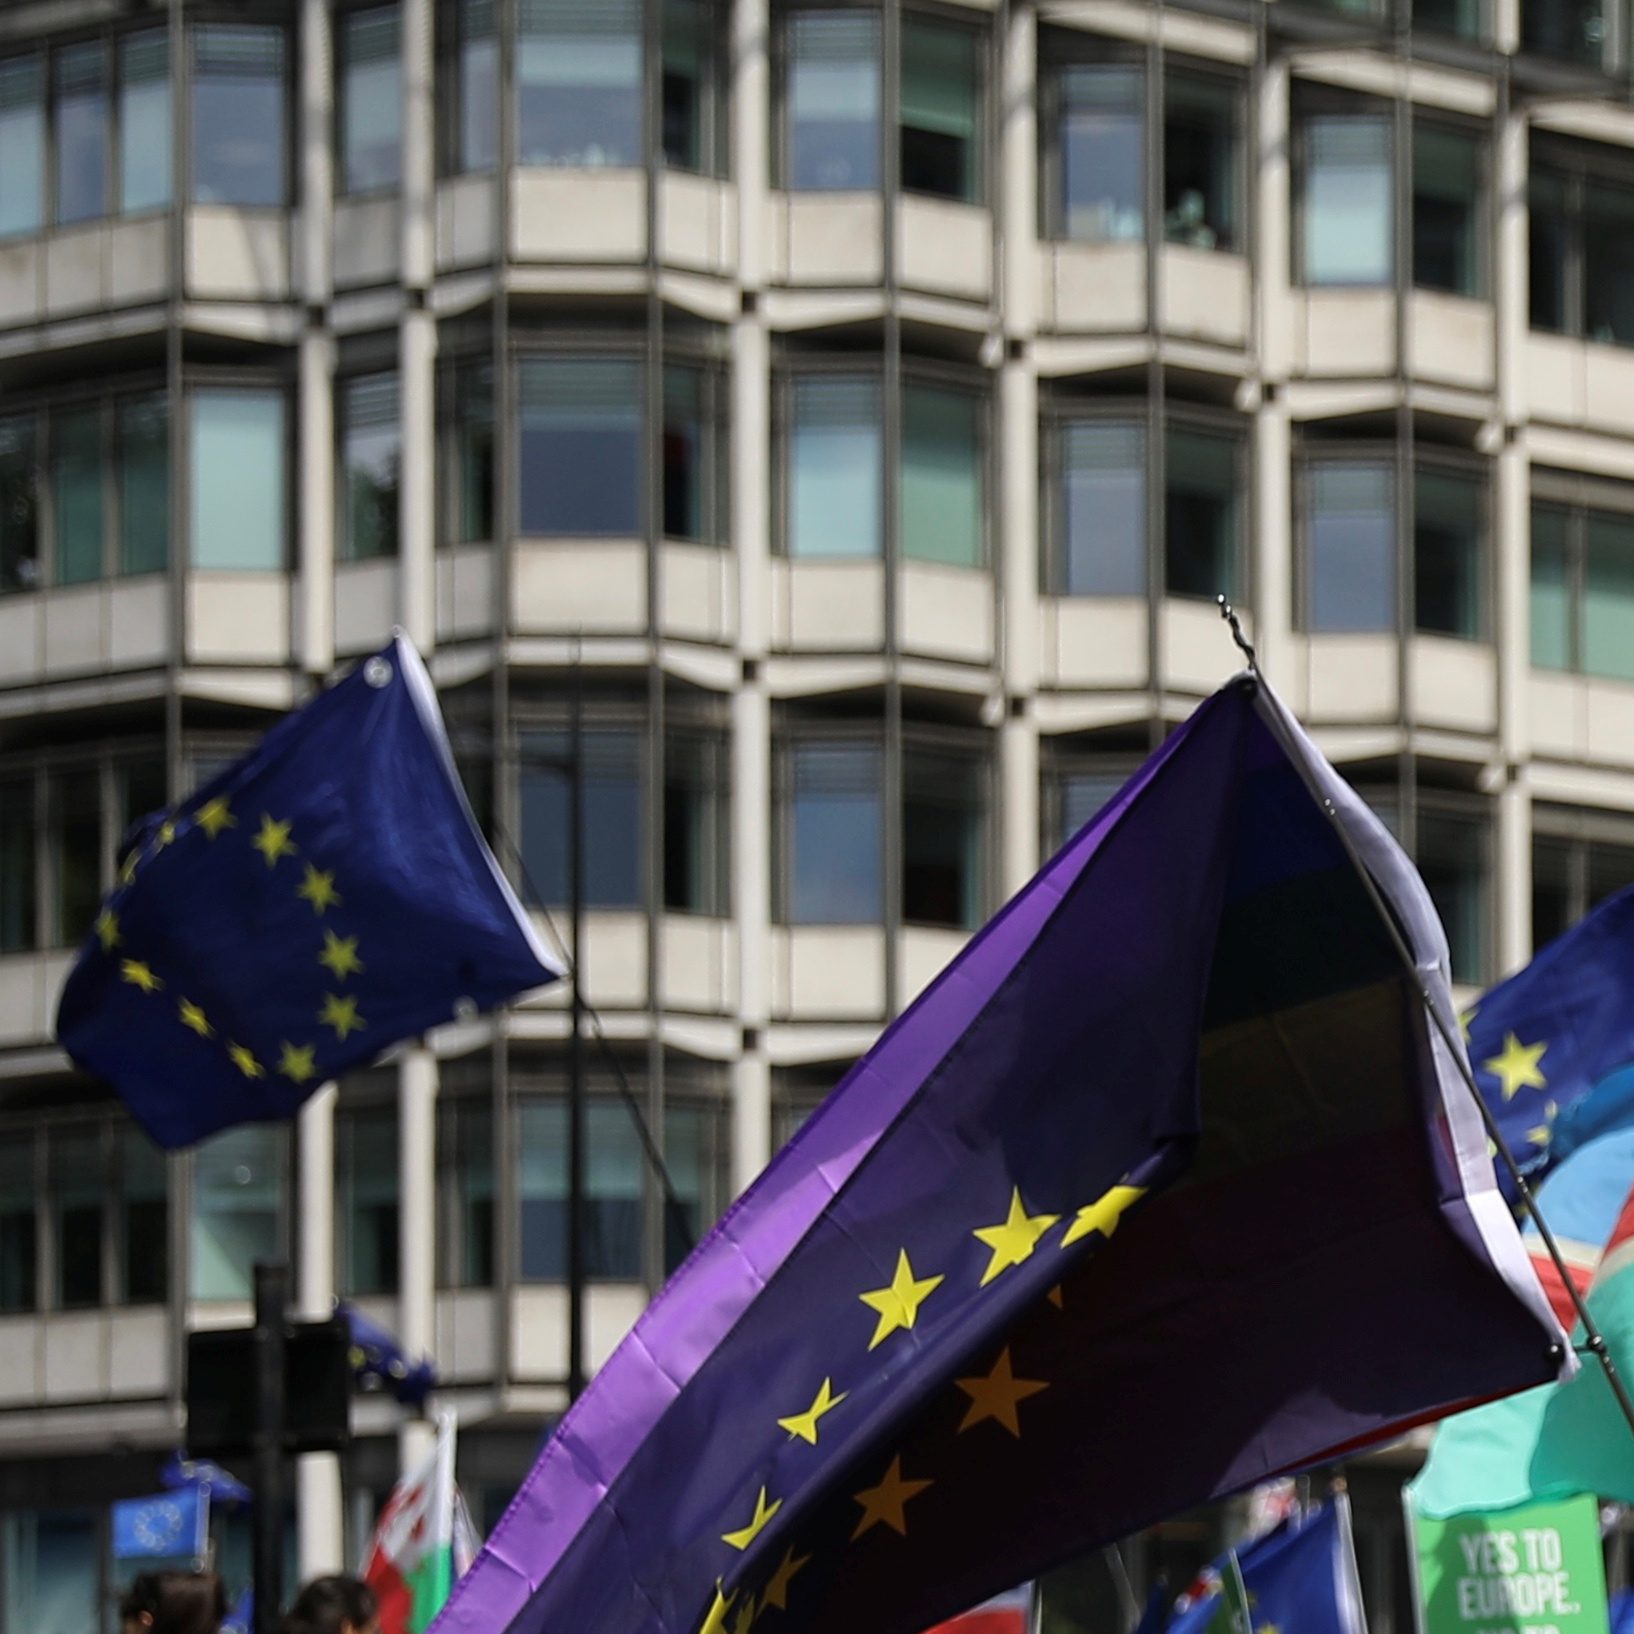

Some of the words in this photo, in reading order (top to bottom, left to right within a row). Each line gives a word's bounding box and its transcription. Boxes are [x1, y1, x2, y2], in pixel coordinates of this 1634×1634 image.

[1460, 1530, 1519, 1574] YES
[1522, 1527, 1562, 1572] TO
[1457, 1571, 1582, 1620] EUROPE.
